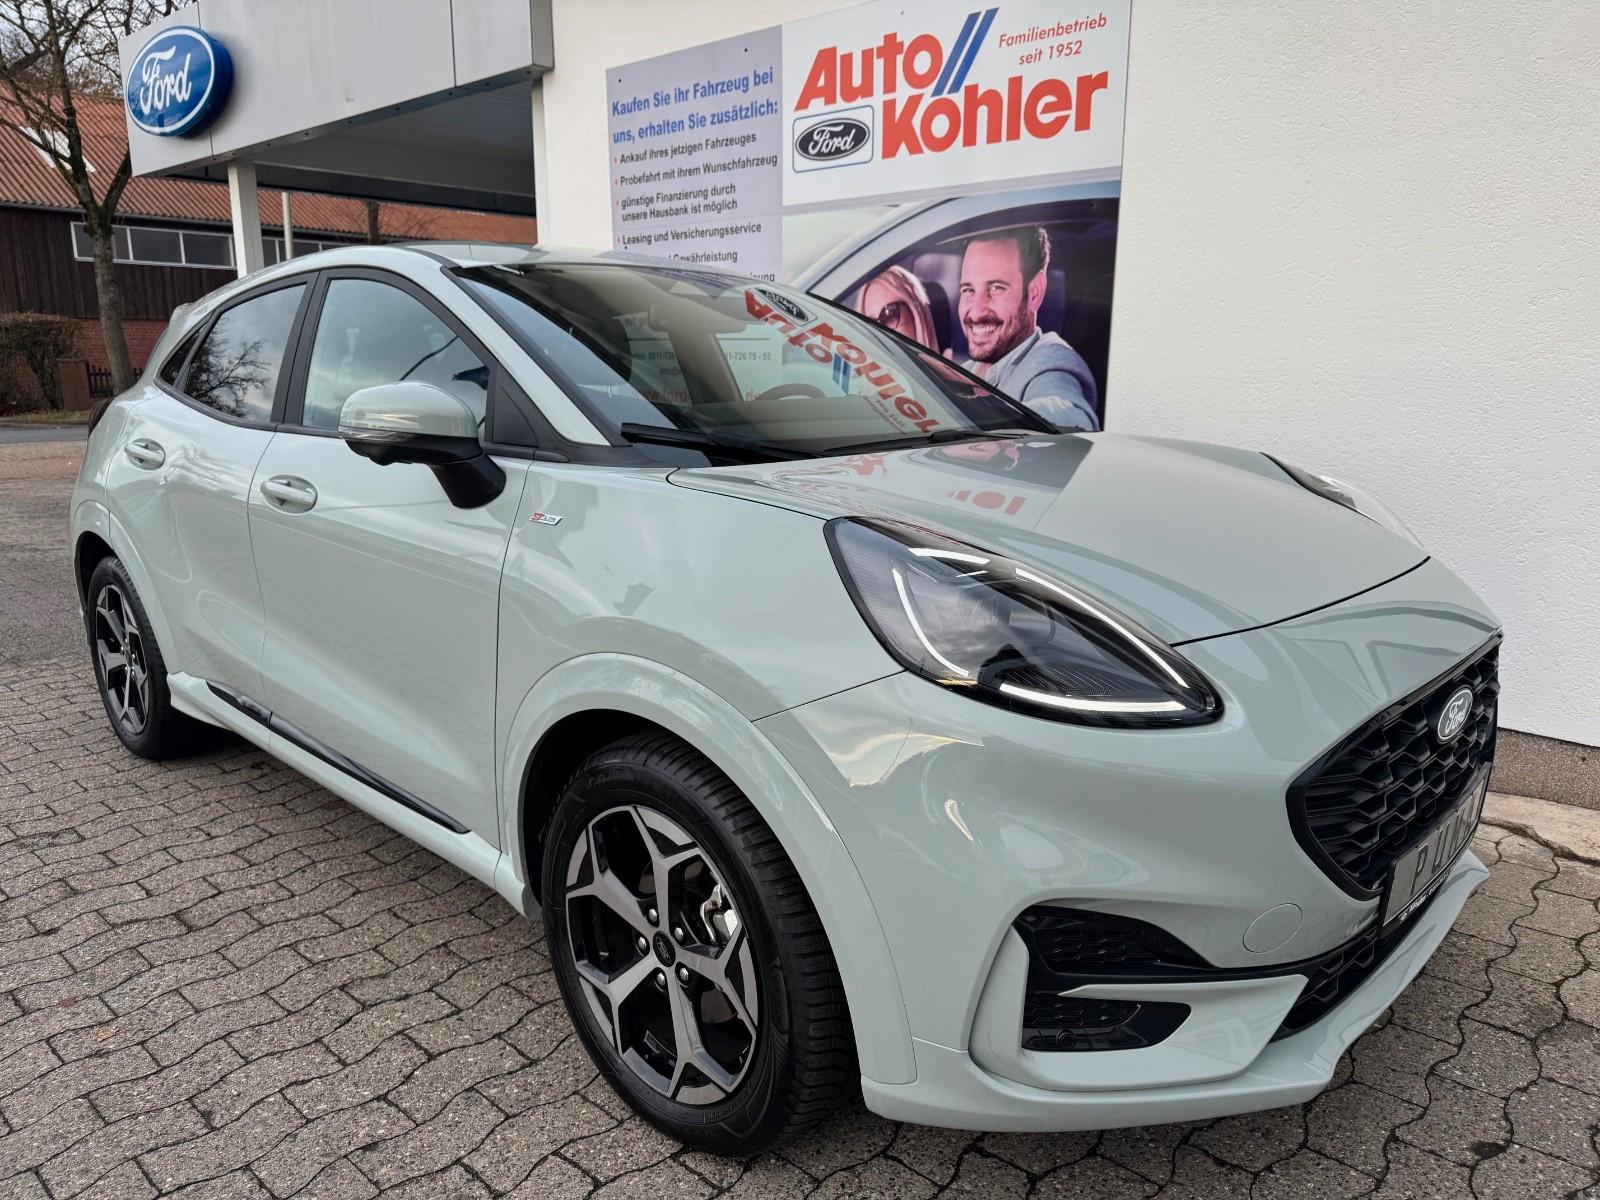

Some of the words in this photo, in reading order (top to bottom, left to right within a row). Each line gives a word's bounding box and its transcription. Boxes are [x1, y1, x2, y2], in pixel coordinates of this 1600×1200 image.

[999, 12, 1108, 48] Familienbetrieb
[1018, 48, 1043, 66] seit
[1048, 40, 1084, 61] 1952
[140, 45, 192, 116] Ford
[794, 32, 944, 112] Auto
[612, 97, 650, 117] Kaufen
[653, 91, 671, 109] Sie
[674, 87, 690, 103] ihr
[693, 75, 749, 100] Fahrzeug
[753, 66, 774, 86] bei
[613, 129, 635, 144] uns,
[638, 120, 685, 140] erhalten
[688, 112, 707, 130] Sie
[710, 98, 779, 126] zusätzlich:
[620, 150, 648, 165] Ankauf
[649, 147, 670, 159] ihres
[670, 142, 703, 158] jetzigen
[705, 132, 757, 151] Fahrzeuges
[808, 124, 855, 154] Ford
[620, 171, 661, 186] Probefahrt
[662, 169, 676, 182] mit
[677, 166, 701, 179] ihrem
[702, 154, 778, 174] Wunschfahrzeug
[621, 195, 655, 210] günstige
[656, 188, 708, 204] Finanzierung
[711, 183, 736, 197] durch
[622, 210, 648, 222] unsere
[650, 206, 688, 219] Hausbank
[691, 203, 701, 215] ist
[703, 199, 738, 215] möglich
[622, 233, 652, 246] Leasing
[654, 231, 669, 242] und
[670, 222, 762, 241] Versicherungsservice
[1445, 698, 1468, 735] Ford
